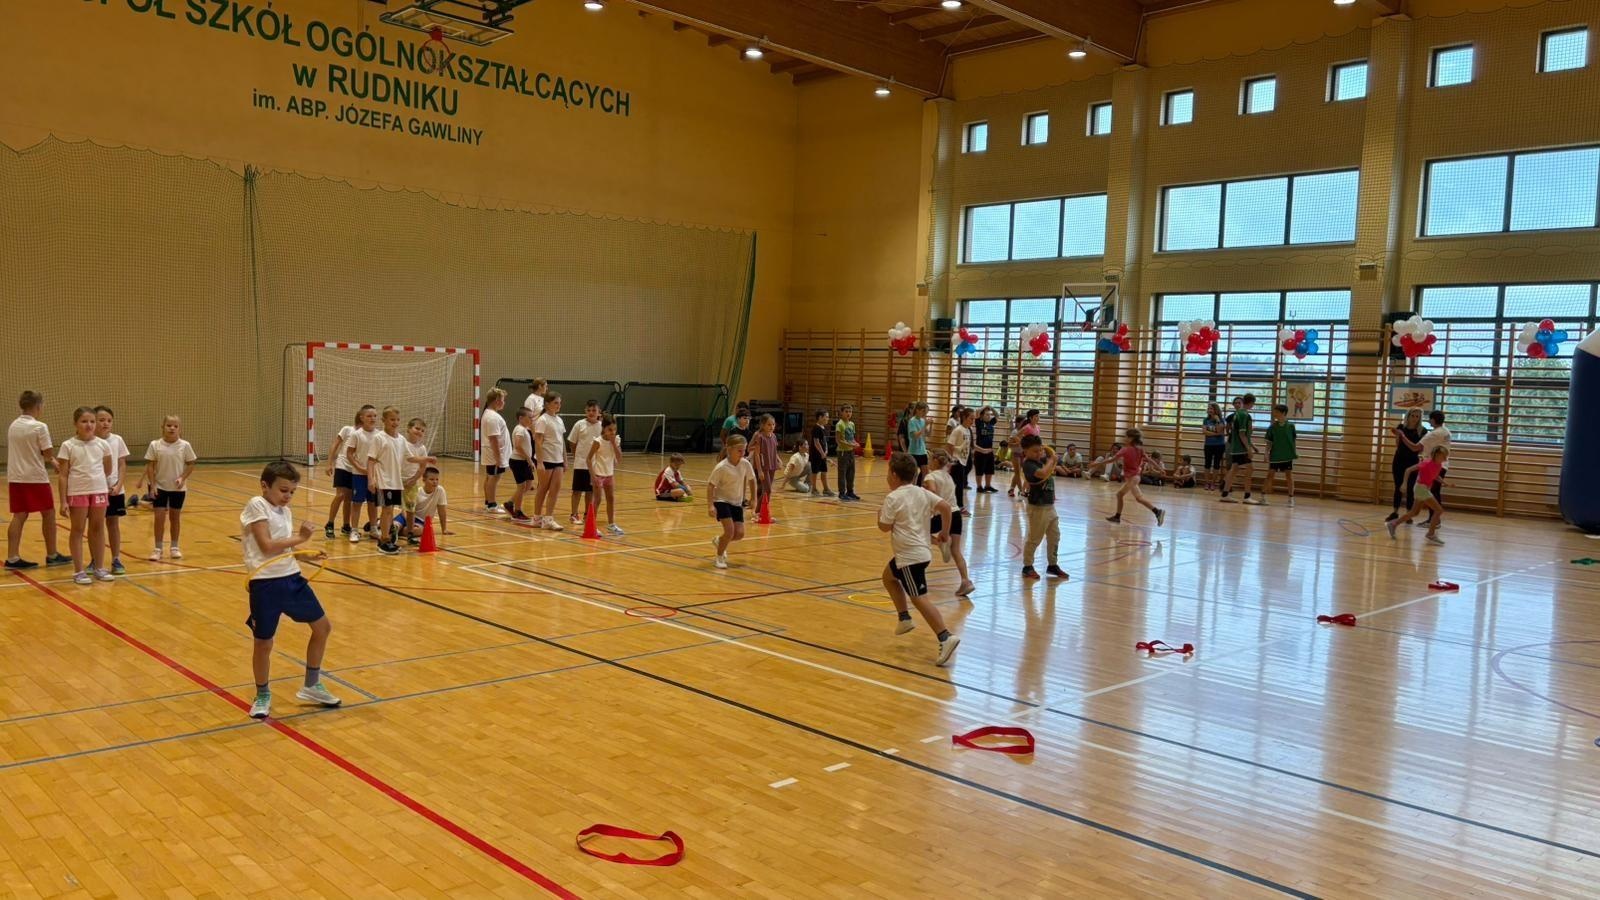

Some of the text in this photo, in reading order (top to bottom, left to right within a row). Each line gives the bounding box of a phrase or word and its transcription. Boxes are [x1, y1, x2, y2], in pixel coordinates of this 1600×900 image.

[185, 0, 631, 116] SZKÓŁ OGÓLNOKSZTAŁCĄCYCH
[252, 88, 484, 145] im. ABP. JÓZEFA GAWLINY
[292, 63, 459, 116] w RUDNIKU
